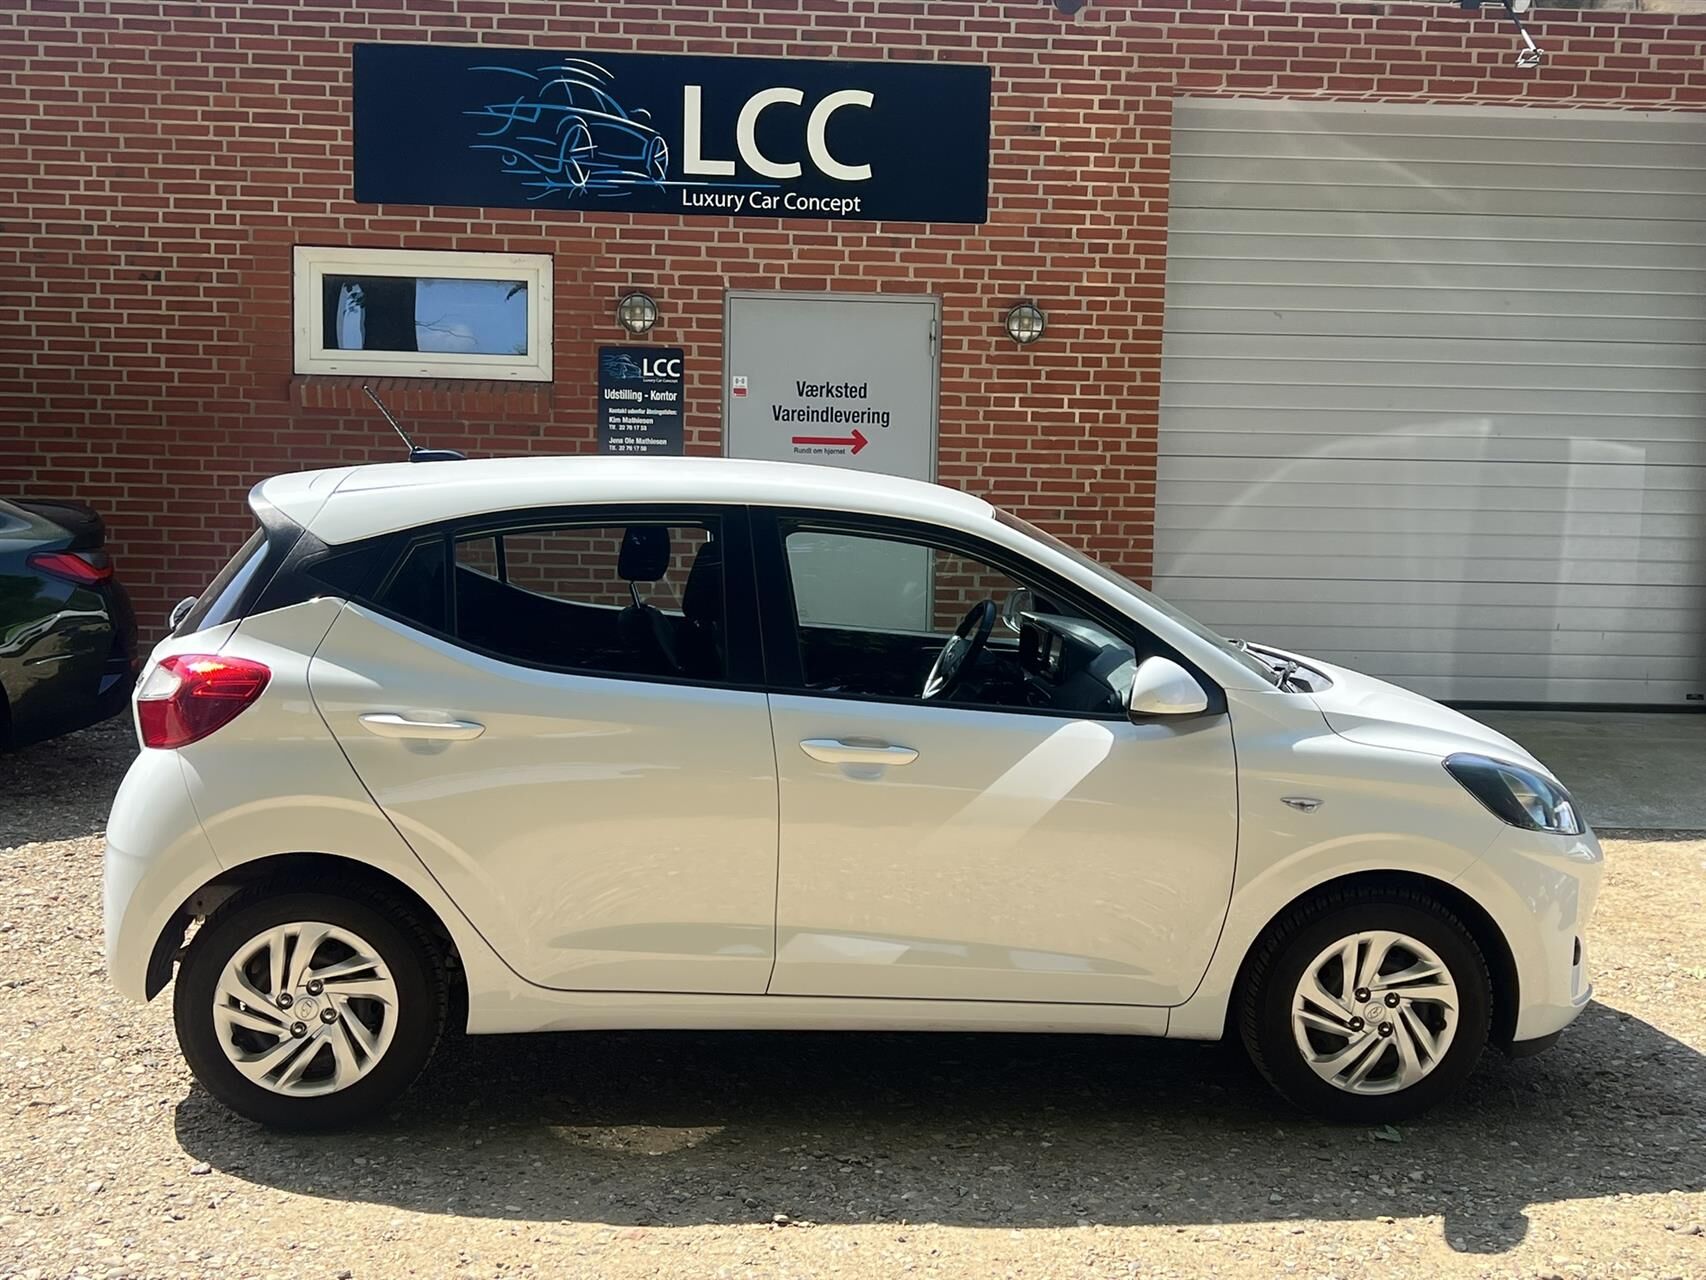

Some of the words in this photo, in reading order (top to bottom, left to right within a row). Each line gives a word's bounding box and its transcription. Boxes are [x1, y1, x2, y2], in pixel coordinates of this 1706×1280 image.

[683, 85, 875, 181] LCC
[682, 188, 745, 212] Luxury
[749, 191, 780, 209] Car
[784, 193, 861, 215] Concept
[642, 358, 681, 377] LCC
[604, 388, 643, 402] Udstilling
[650, 390, 678, 401] Kontor
[796, 380, 868, 399] Værksted
[772, 404, 890, 428] Vareindlevering
